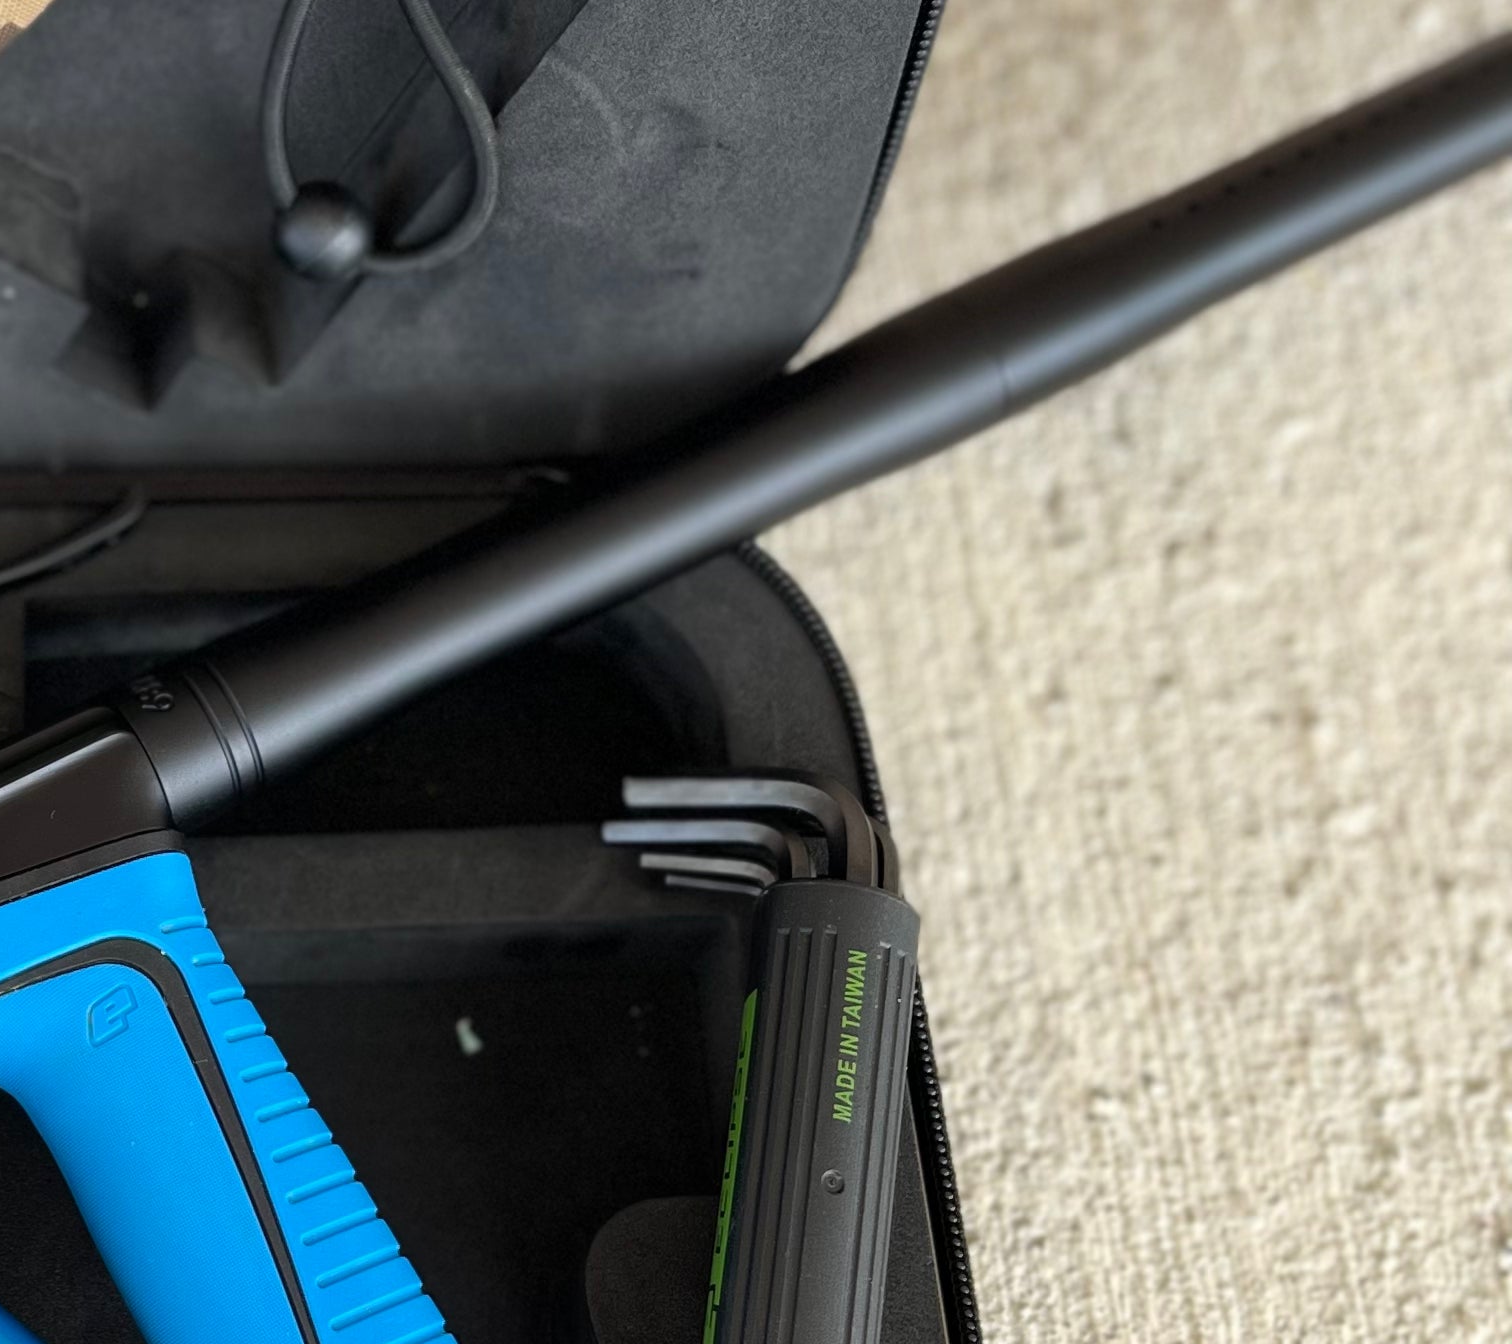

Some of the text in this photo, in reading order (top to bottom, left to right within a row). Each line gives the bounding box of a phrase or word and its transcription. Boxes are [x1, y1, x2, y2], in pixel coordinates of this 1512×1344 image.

[833, 949, 868, 1123] MADE IN TAIWAN
